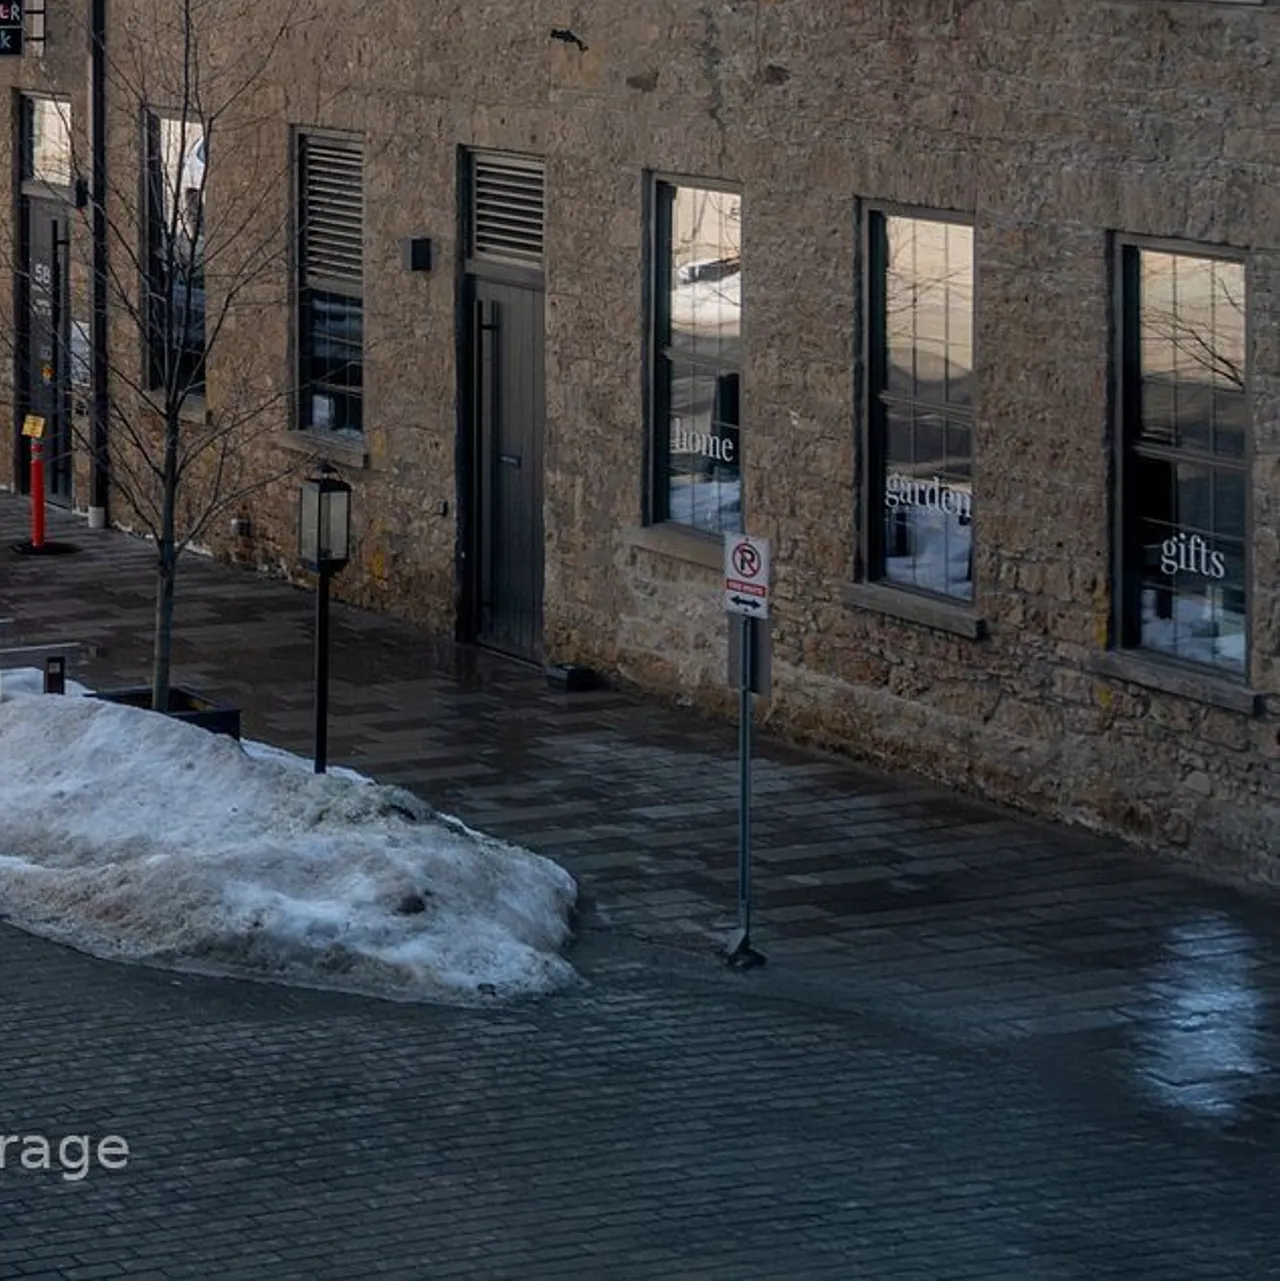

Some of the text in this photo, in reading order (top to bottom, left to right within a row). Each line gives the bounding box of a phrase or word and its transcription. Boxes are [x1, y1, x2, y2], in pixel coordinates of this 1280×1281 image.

[674, 417, 735, 462] home
[884, 473, 972, 518] garden
[1160, 532, 1225, 579] gifts
